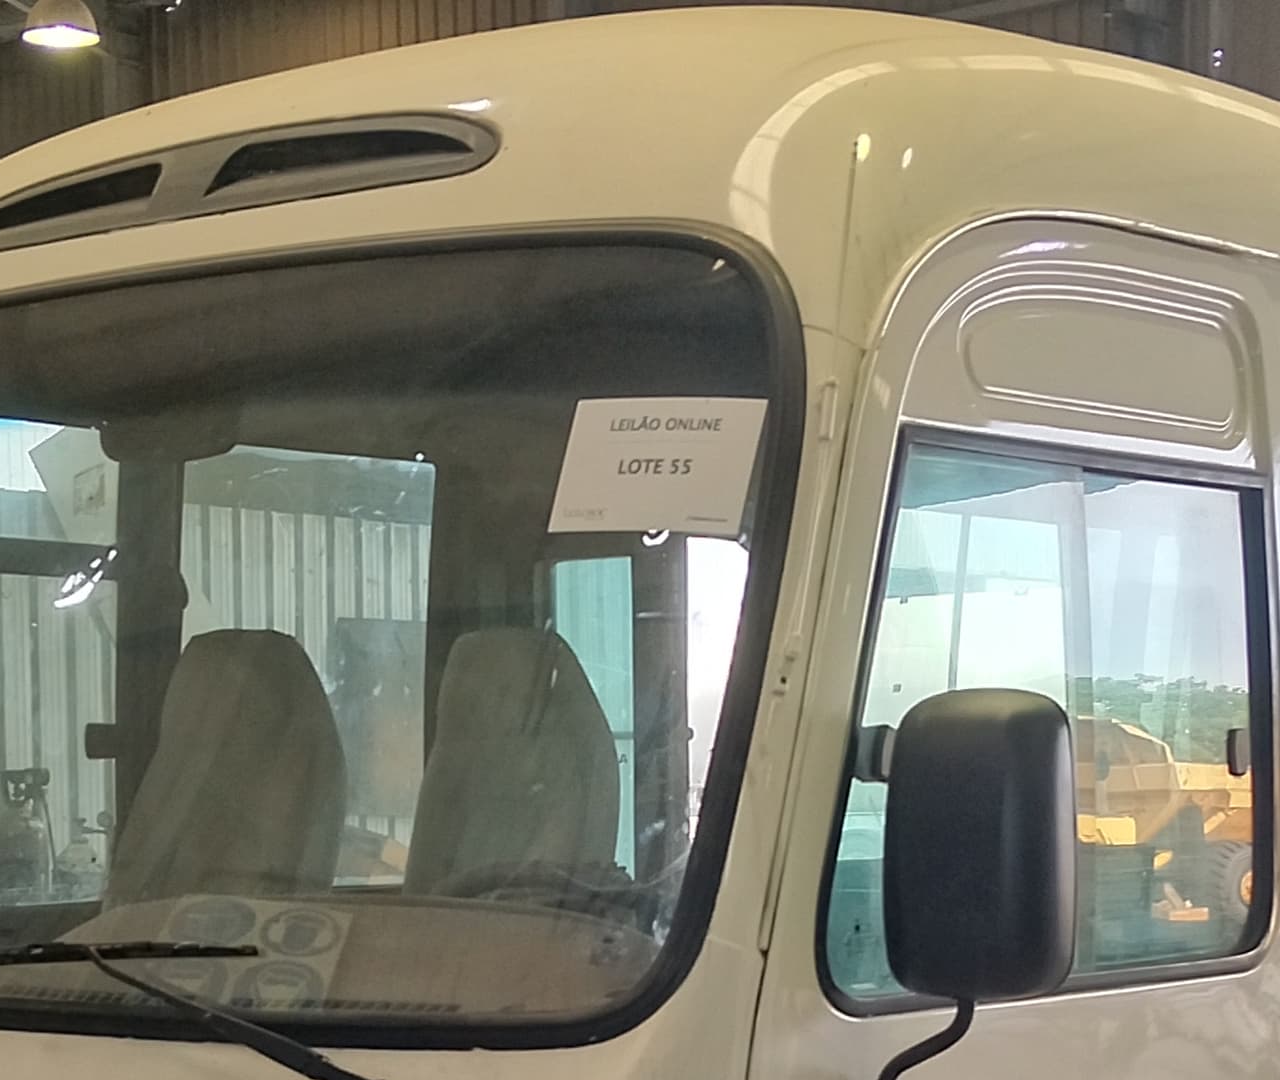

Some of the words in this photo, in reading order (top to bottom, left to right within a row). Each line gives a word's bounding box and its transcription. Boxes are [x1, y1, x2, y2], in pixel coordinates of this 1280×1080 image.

[610, 416, 660, 432] LEILÃO
[664, 417, 722, 432] ONLINE
[618, 459, 664, 475] LOTE
[669, 459, 693, 475] 55
